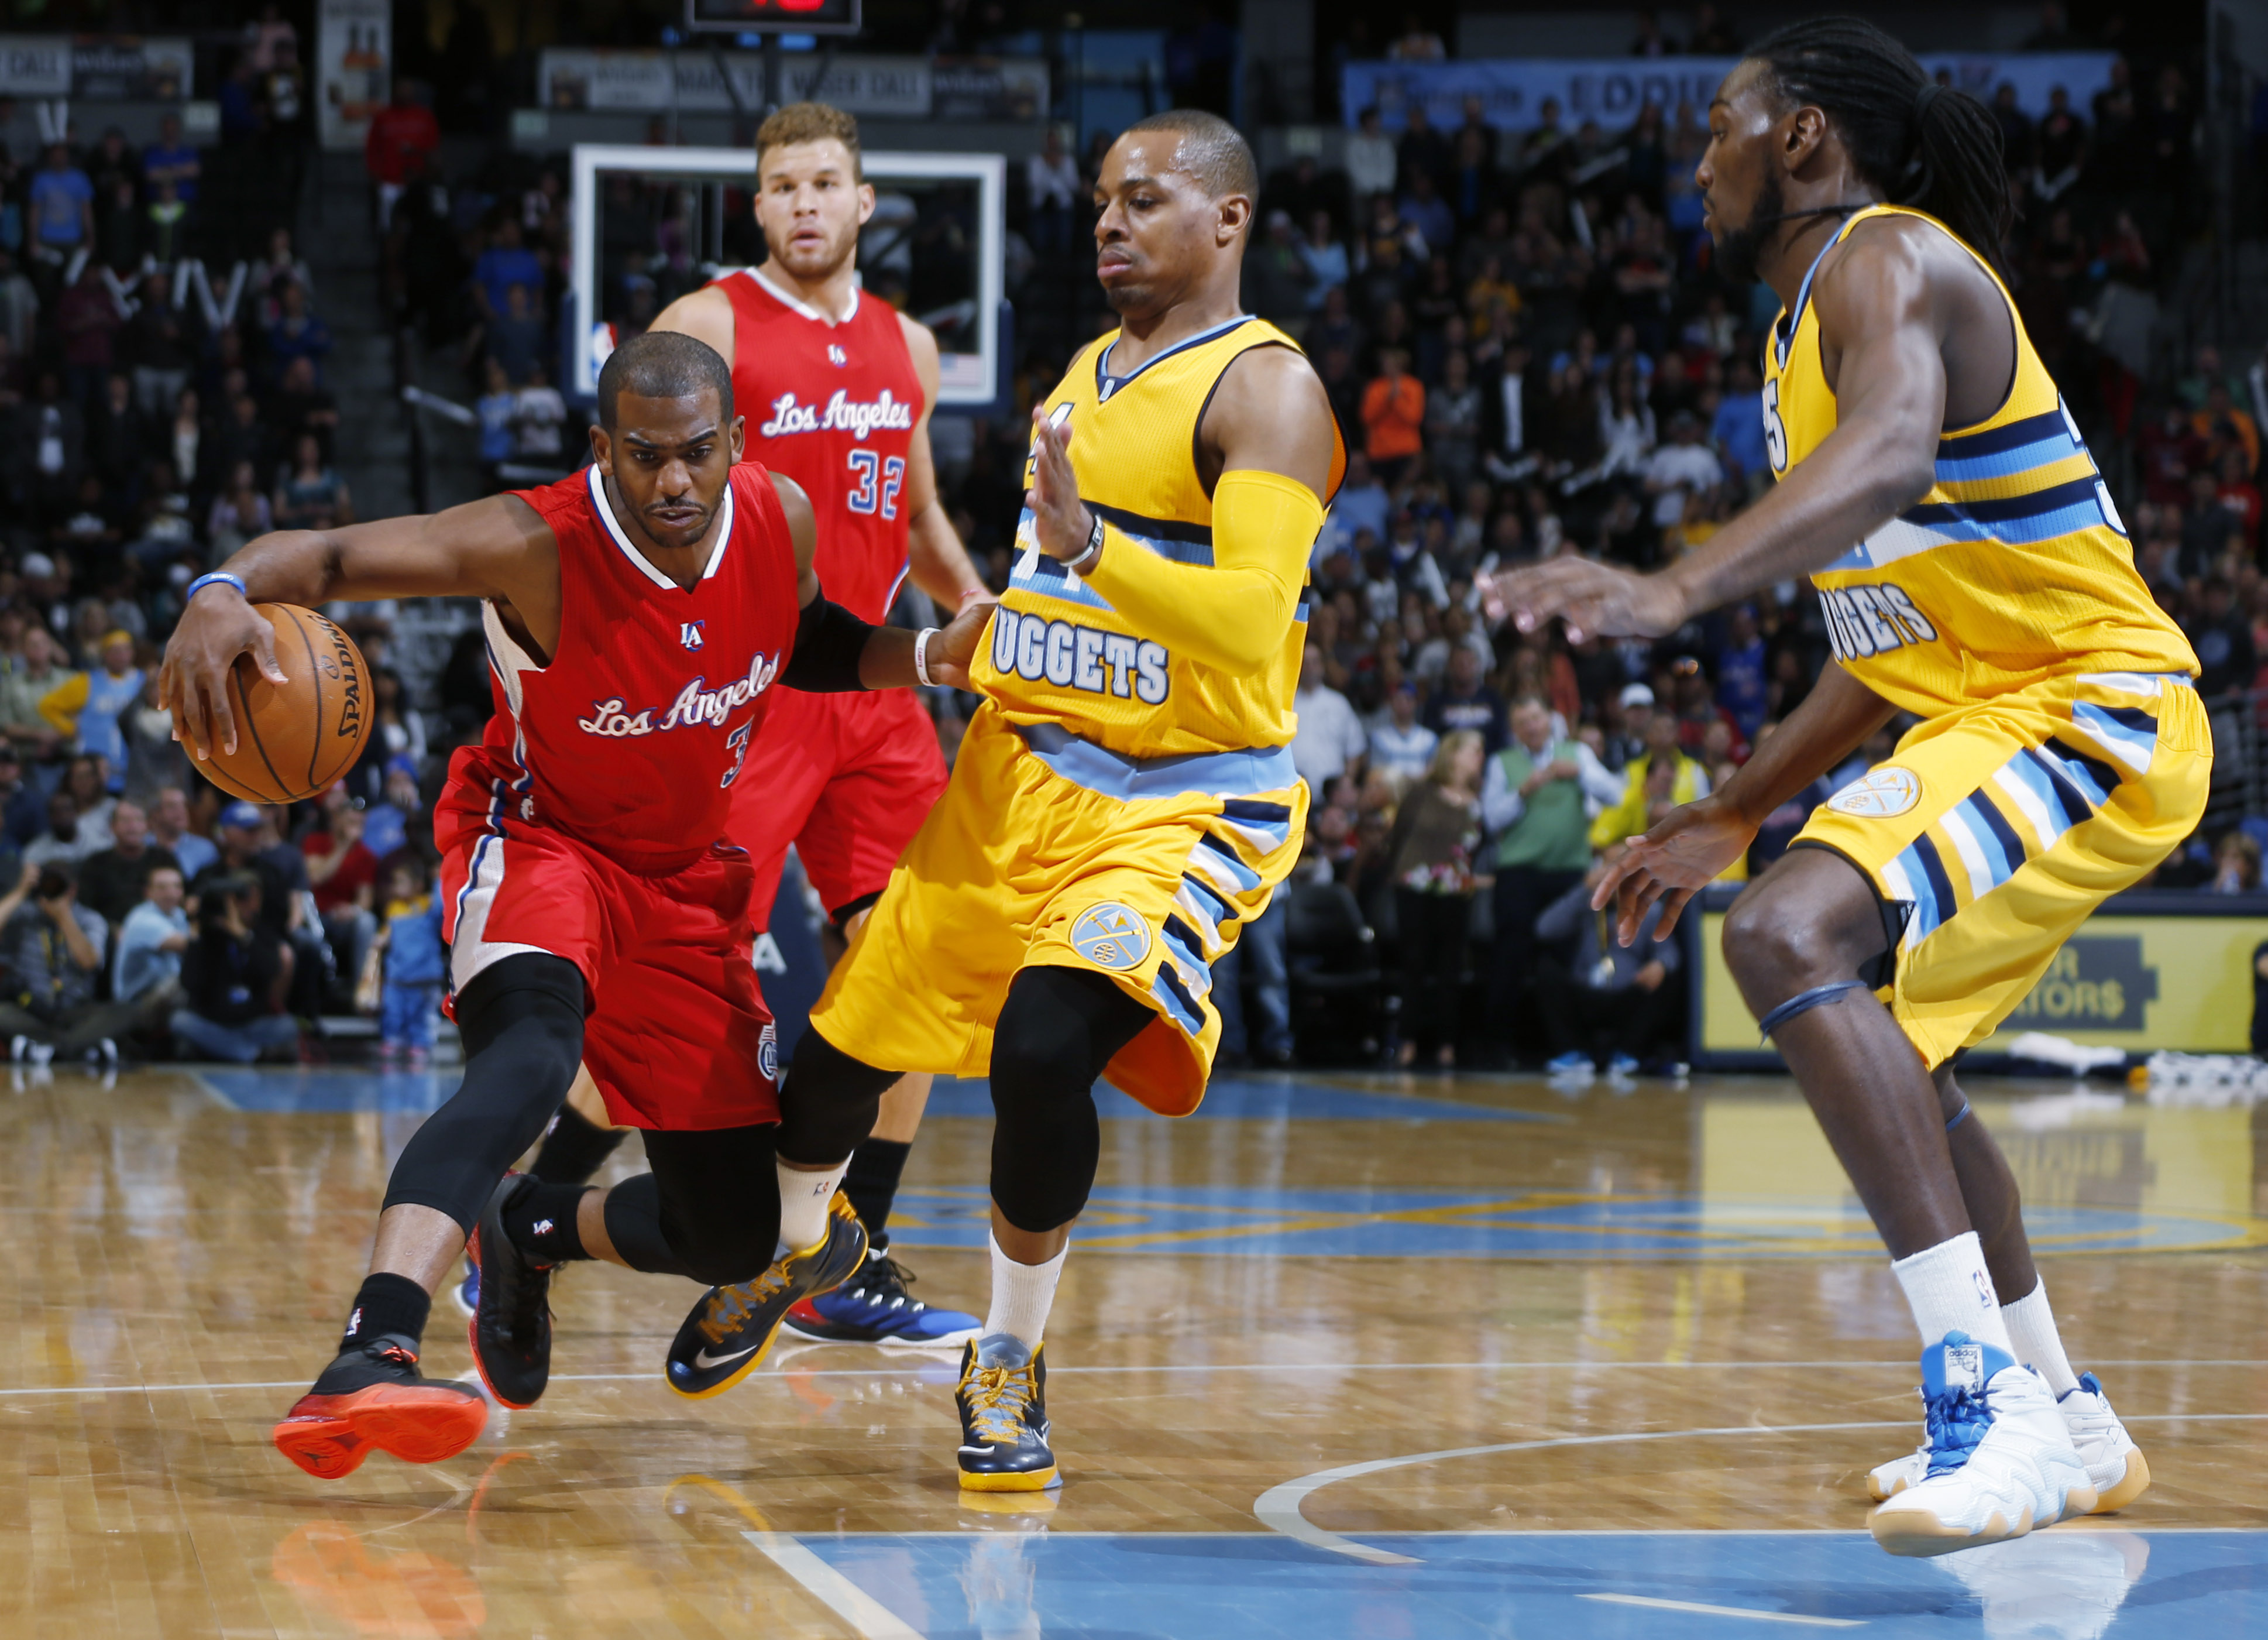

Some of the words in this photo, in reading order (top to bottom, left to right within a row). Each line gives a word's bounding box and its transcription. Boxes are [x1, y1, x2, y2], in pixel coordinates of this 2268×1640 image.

[761, 392, 817, 437] Los
[820, 389, 912, 441] Angeles
[847, 448, 906, 520] 32
[307, 614, 360, 739] SPALDING
[990, 604, 1170, 706] UGGETS
[577, 696, 658, 739] Los
[720, 714, 755, 789] 3
[1949, 1349, 1978, 1357] adidas
